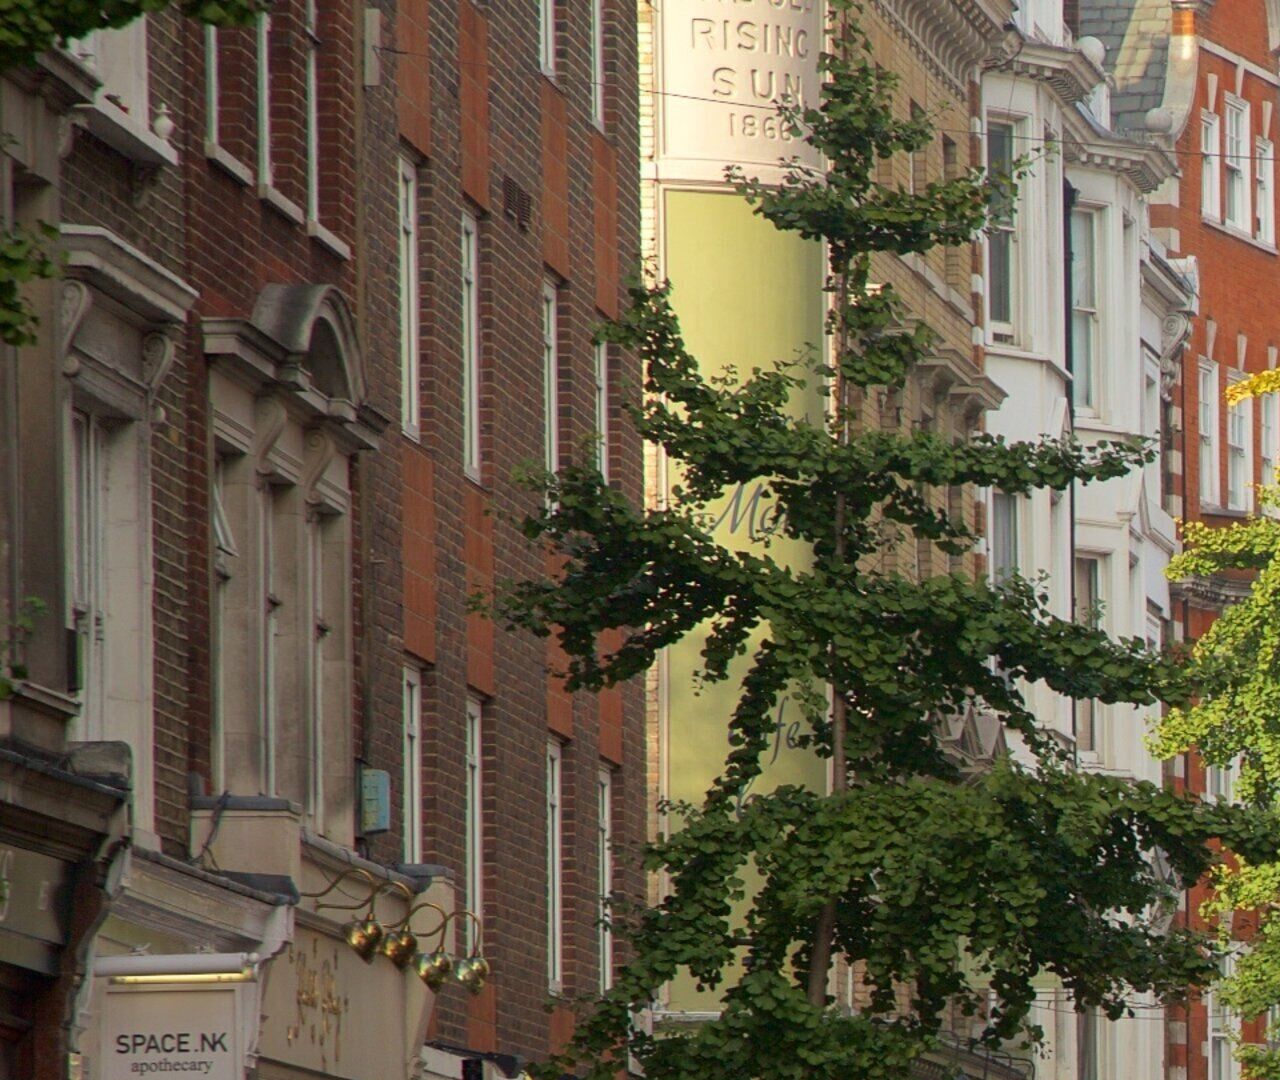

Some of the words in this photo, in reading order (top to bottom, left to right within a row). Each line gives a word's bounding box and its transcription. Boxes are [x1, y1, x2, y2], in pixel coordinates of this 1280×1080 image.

[712, 66, 803, 108] SUN
[116, 1032, 228, 1054] SPACE.NK
[131, 1058, 214, 1076] apothecary
